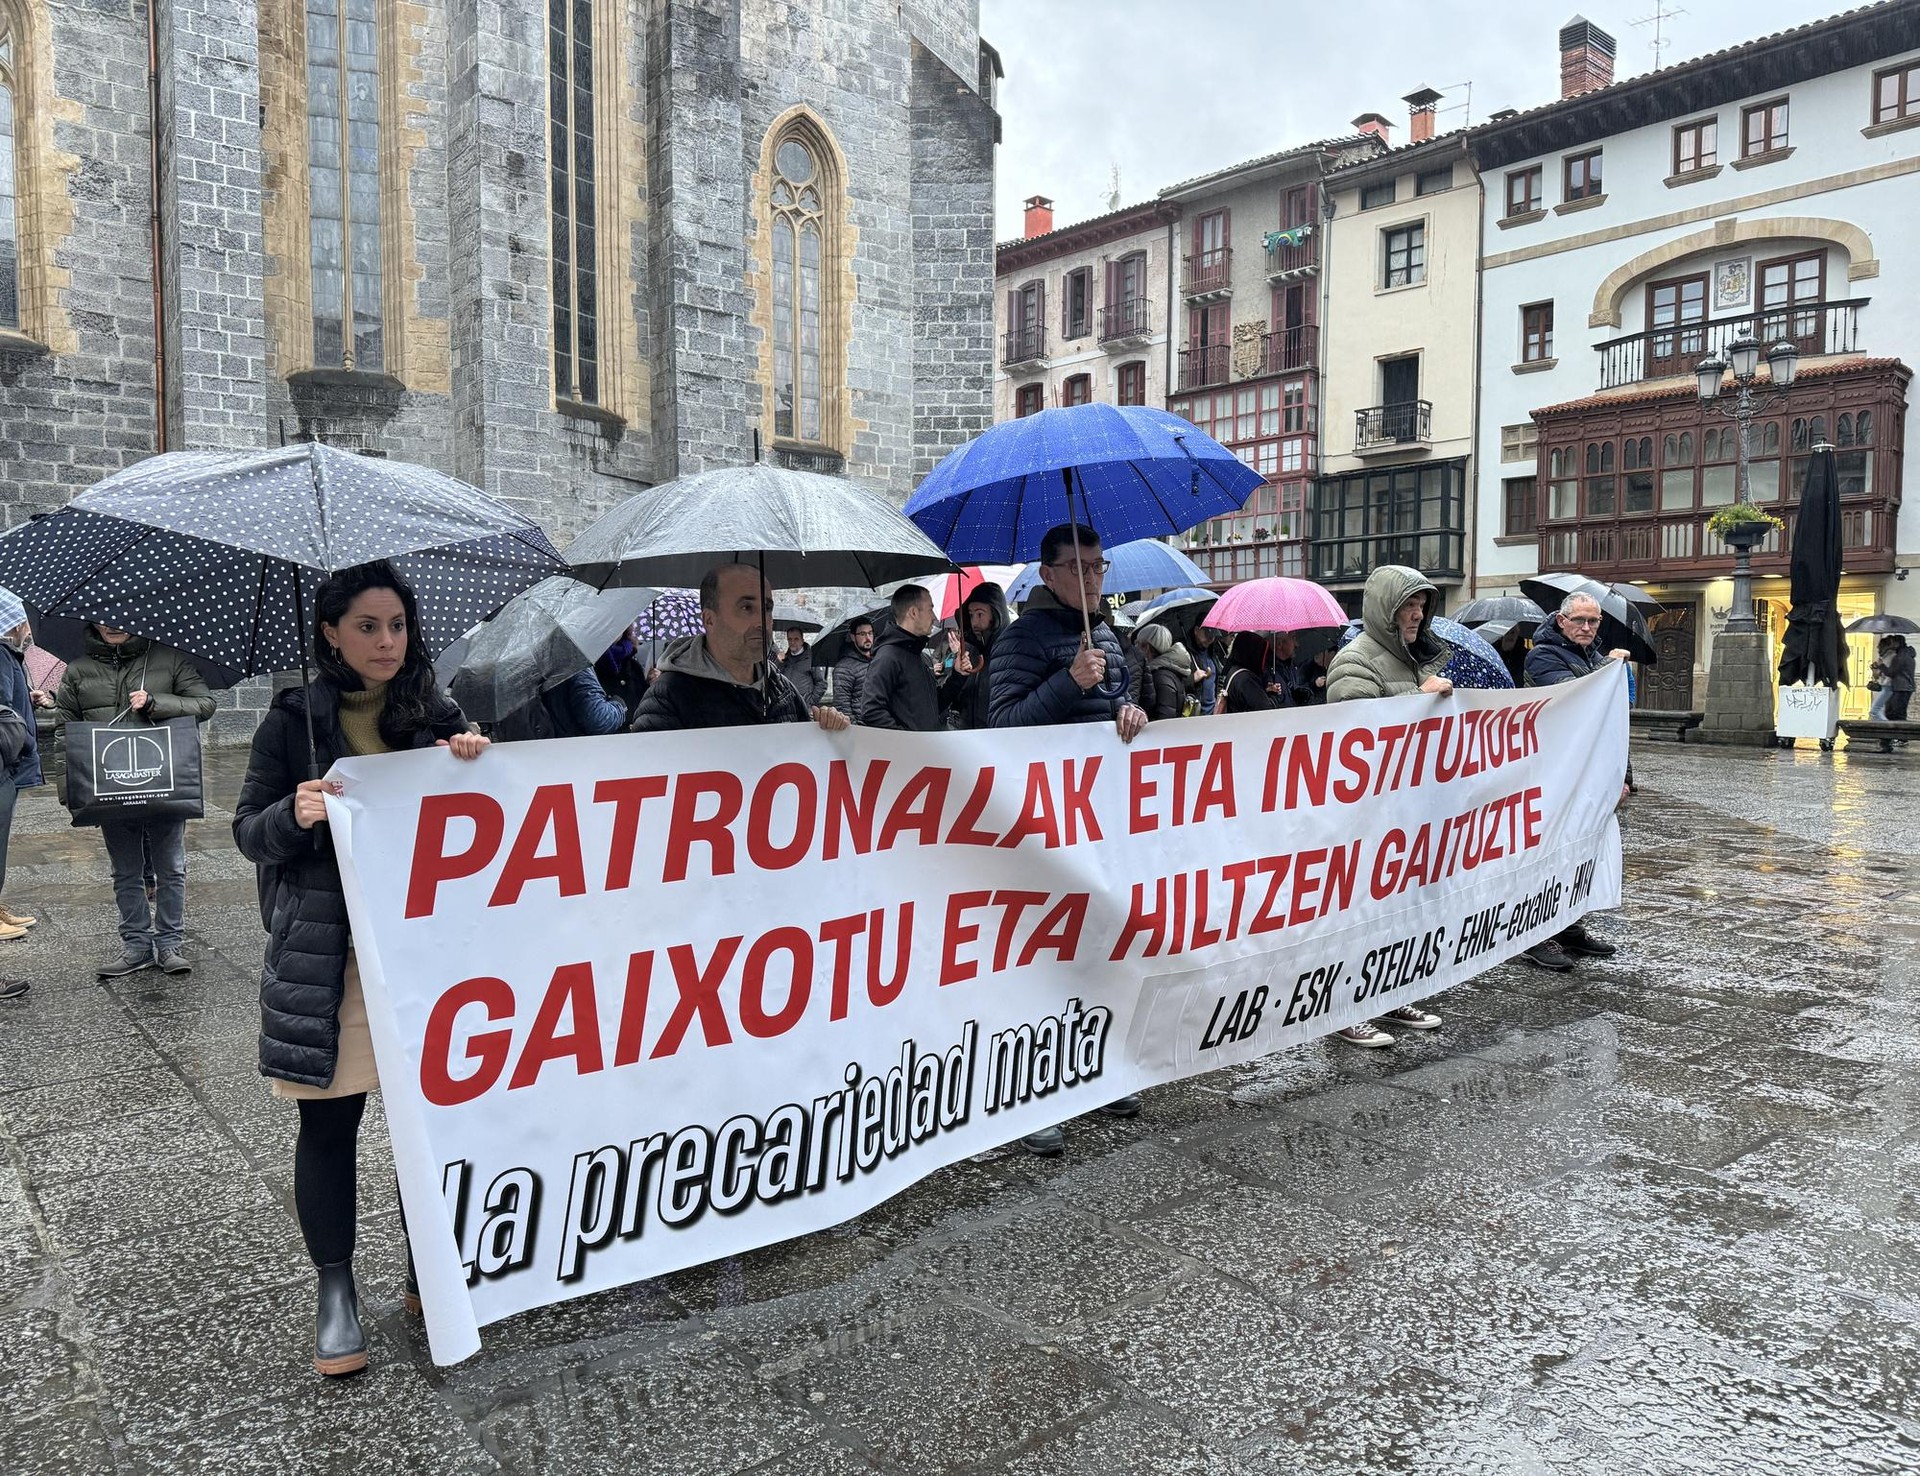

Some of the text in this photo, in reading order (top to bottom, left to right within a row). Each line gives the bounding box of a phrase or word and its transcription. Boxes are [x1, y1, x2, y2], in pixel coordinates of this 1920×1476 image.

[105, 771, 161, 779] LASAGABASTER
[404, 698, 1552, 919] PATRONALAK ETA INSTITUZIOEK
[420, 787, 1542, 1106] GAIXOTU ETA HILTZEN GAITUZTE
[1198, 985, 1270, 1051] LAB
[1281, 961, 1344, 1028] ESK
[1353, 926, 1446, 1004] STEILAS
[1453, 874, 1562, 966] EHNE-etxalde
[556, 1019, 978, 1284] precariedad
[983, 997, 1113, 1116] mata
